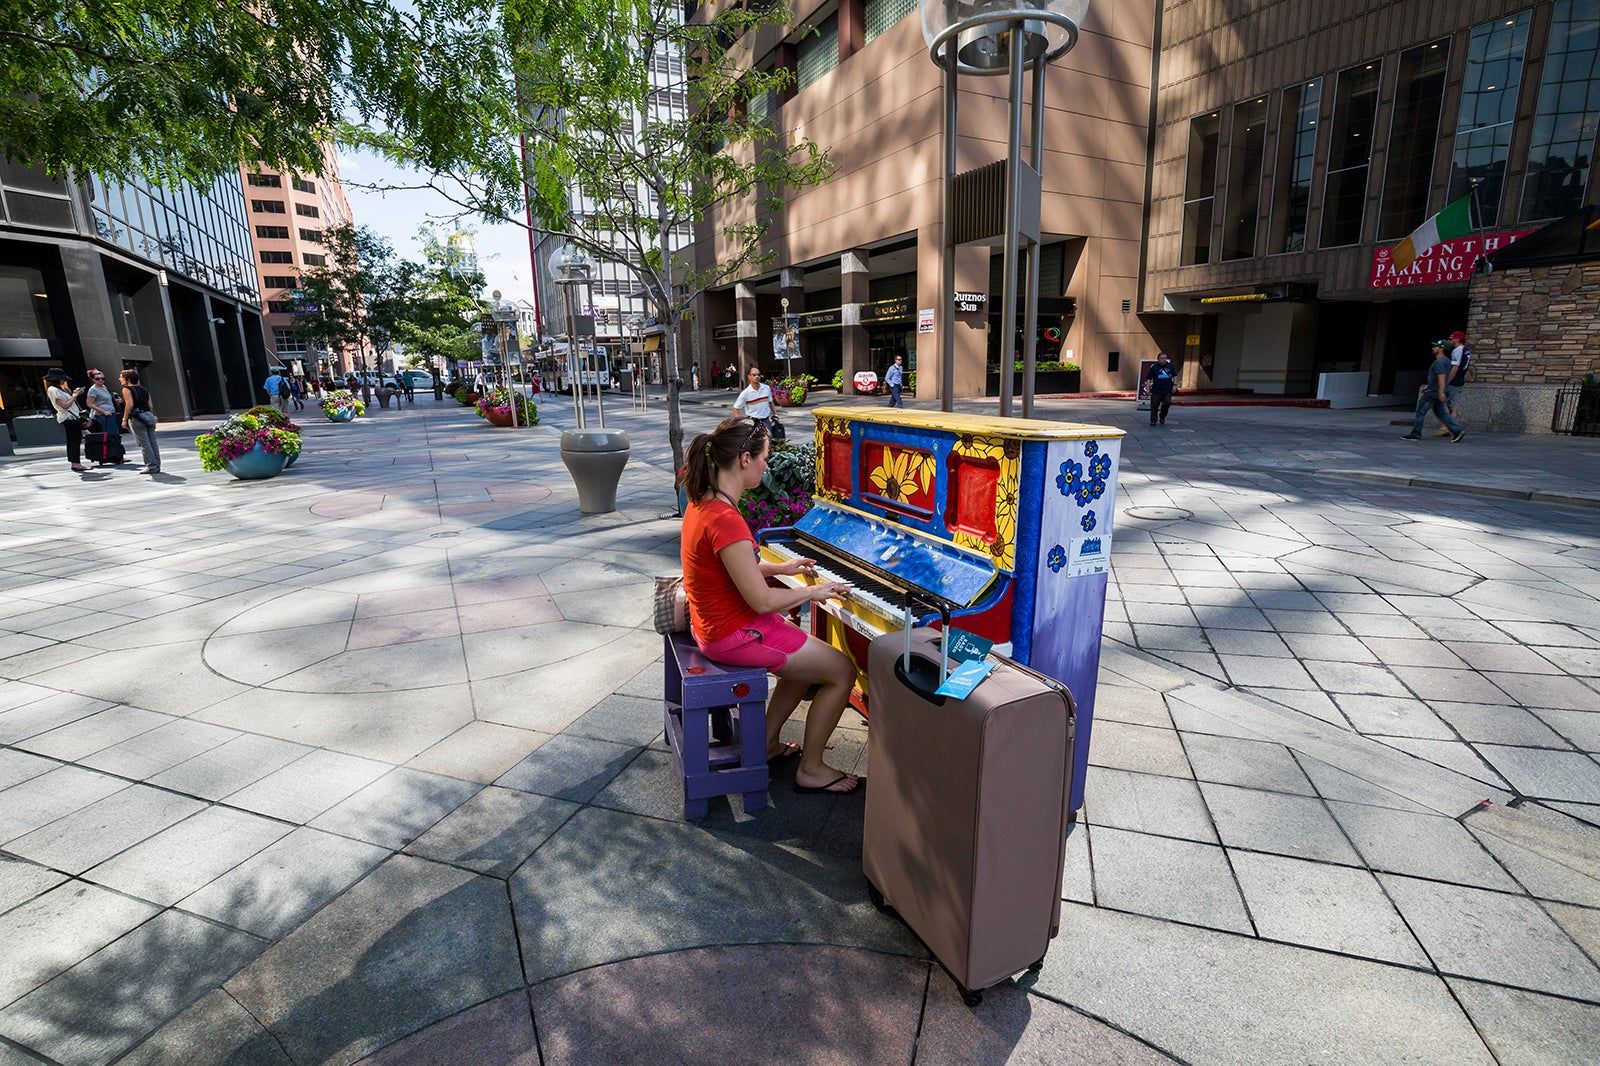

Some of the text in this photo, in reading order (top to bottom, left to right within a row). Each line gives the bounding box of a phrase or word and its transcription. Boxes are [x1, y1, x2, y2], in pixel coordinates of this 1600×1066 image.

[1420, 235, 1518, 258] ONTH
[1376, 255, 1463, 277] PARKING
[1372, 271, 1464, 288] CALL: 303
[957, 638, 968, 653] EASY
